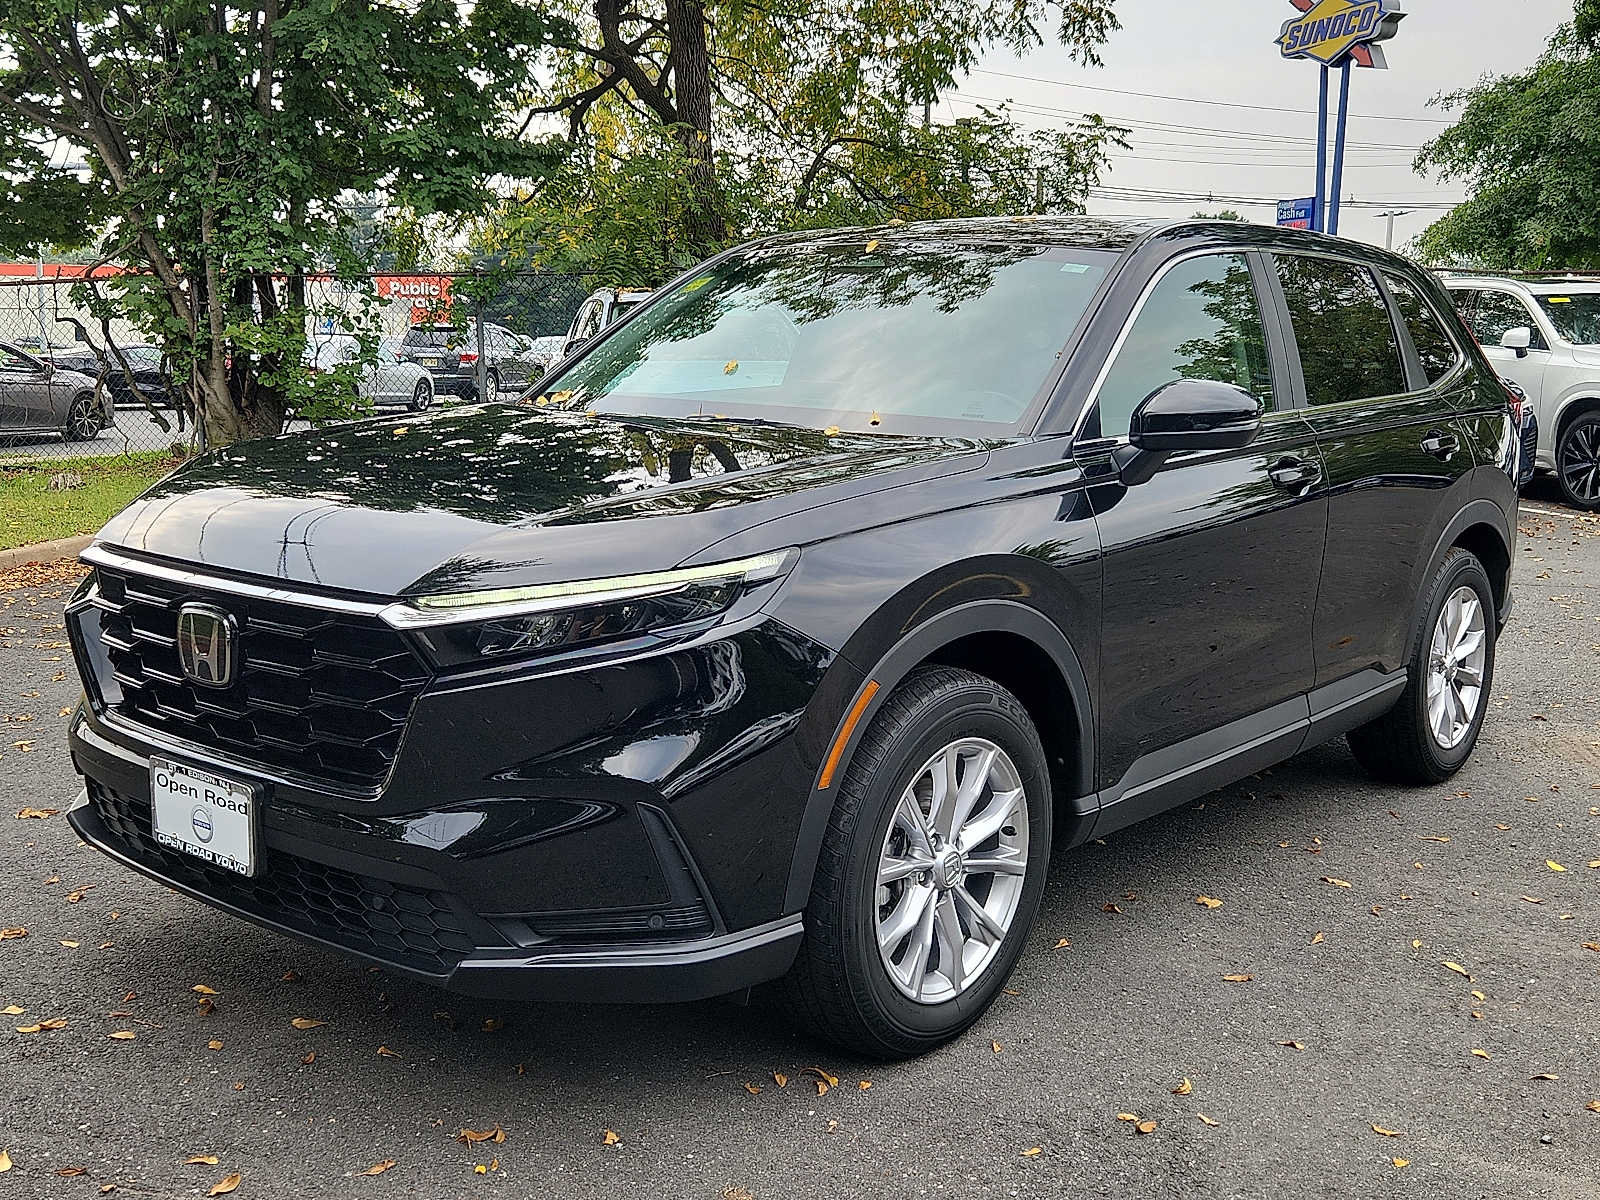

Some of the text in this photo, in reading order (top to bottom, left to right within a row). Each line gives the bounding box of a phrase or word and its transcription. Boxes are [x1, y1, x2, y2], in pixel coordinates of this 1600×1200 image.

[1285, 5, 1376, 51] SUNOCO
[1278, 207, 1295, 220] Cash
[389, 281, 440, 296] Public
[157, 773, 248, 816] Open Road
[158, 833, 247, 874] OPEN ROAD VOLVO
